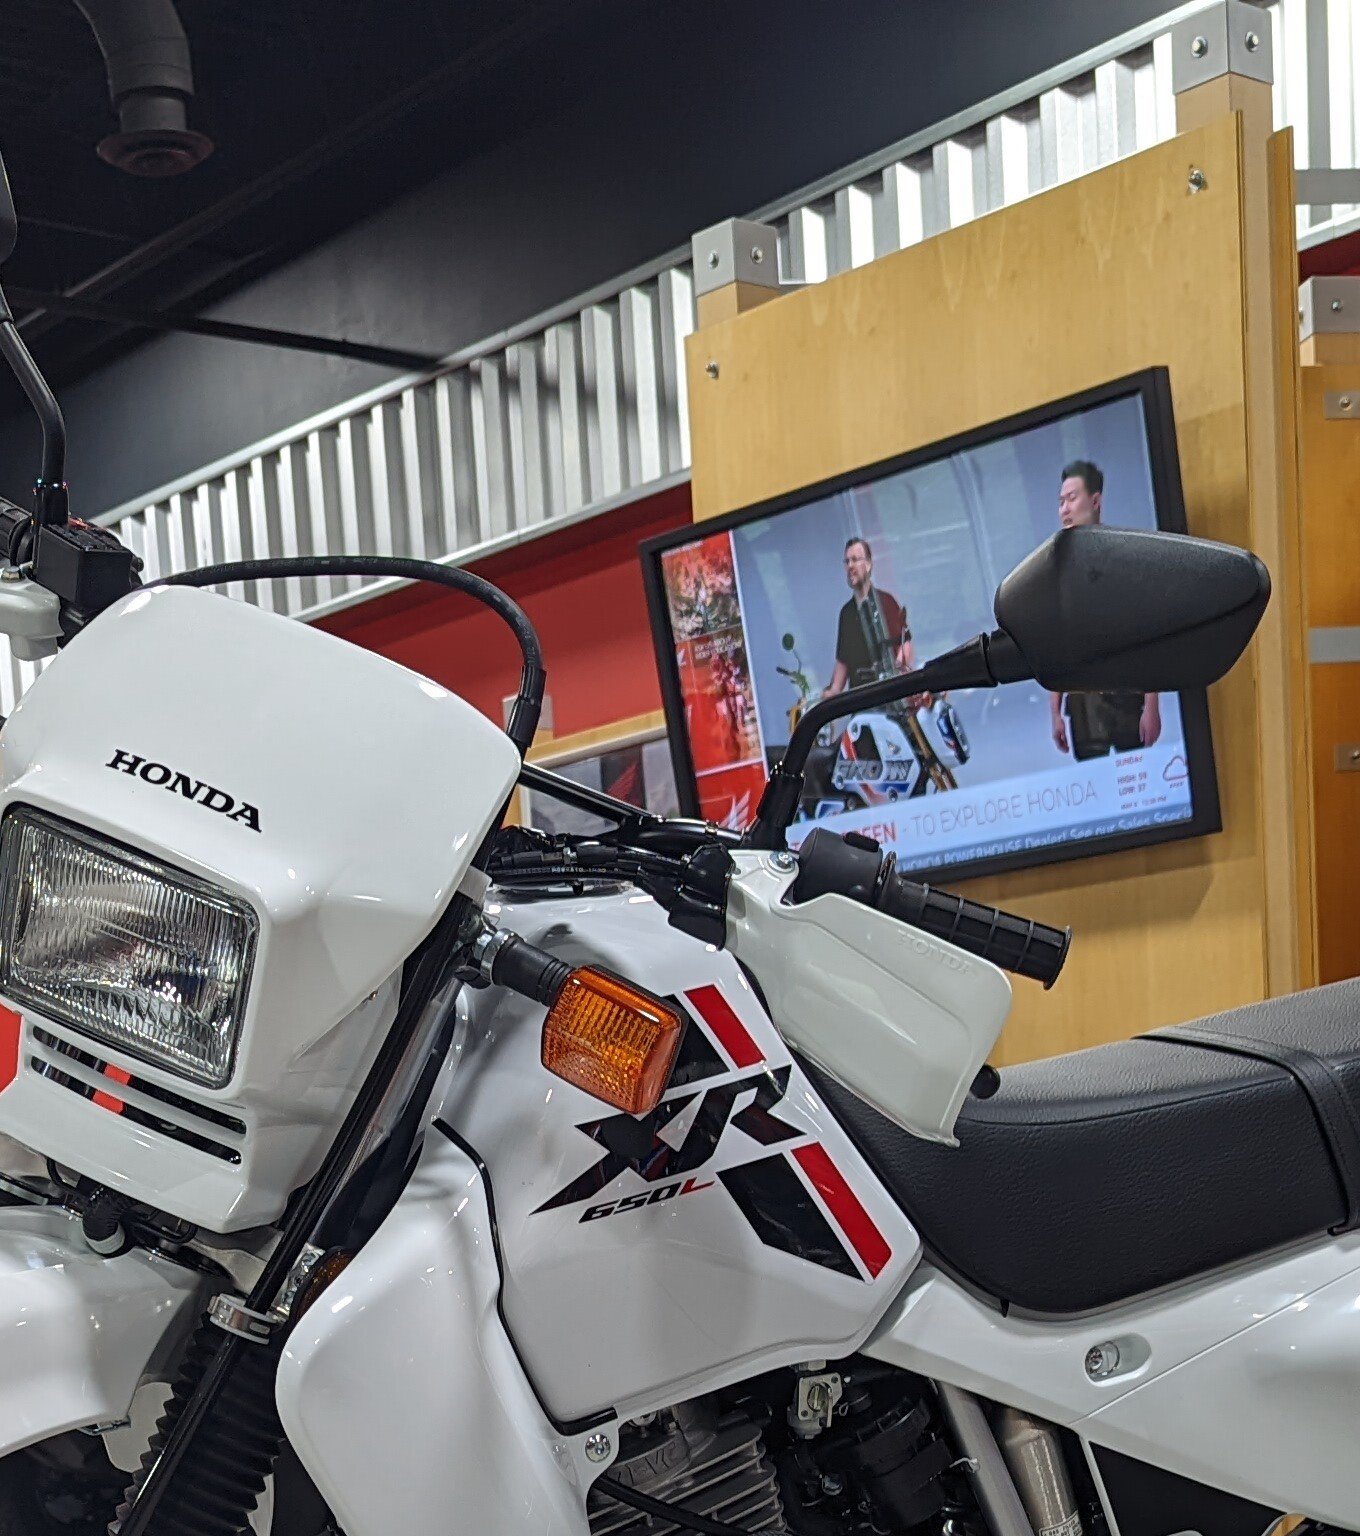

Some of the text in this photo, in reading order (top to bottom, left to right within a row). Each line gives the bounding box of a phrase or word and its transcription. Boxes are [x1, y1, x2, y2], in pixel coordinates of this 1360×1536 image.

[105, 749, 262, 833] HONDA
[911, 814, 936, 836] TO
[941, 794, 1023, 833] EXPLORE
[1028, 780, 1097, 814] HONDA
[896, 928, 974, 975] HONDA
[529, 1064, 807, 1216] XR
[578, 1177, 715, 1224] 650L
